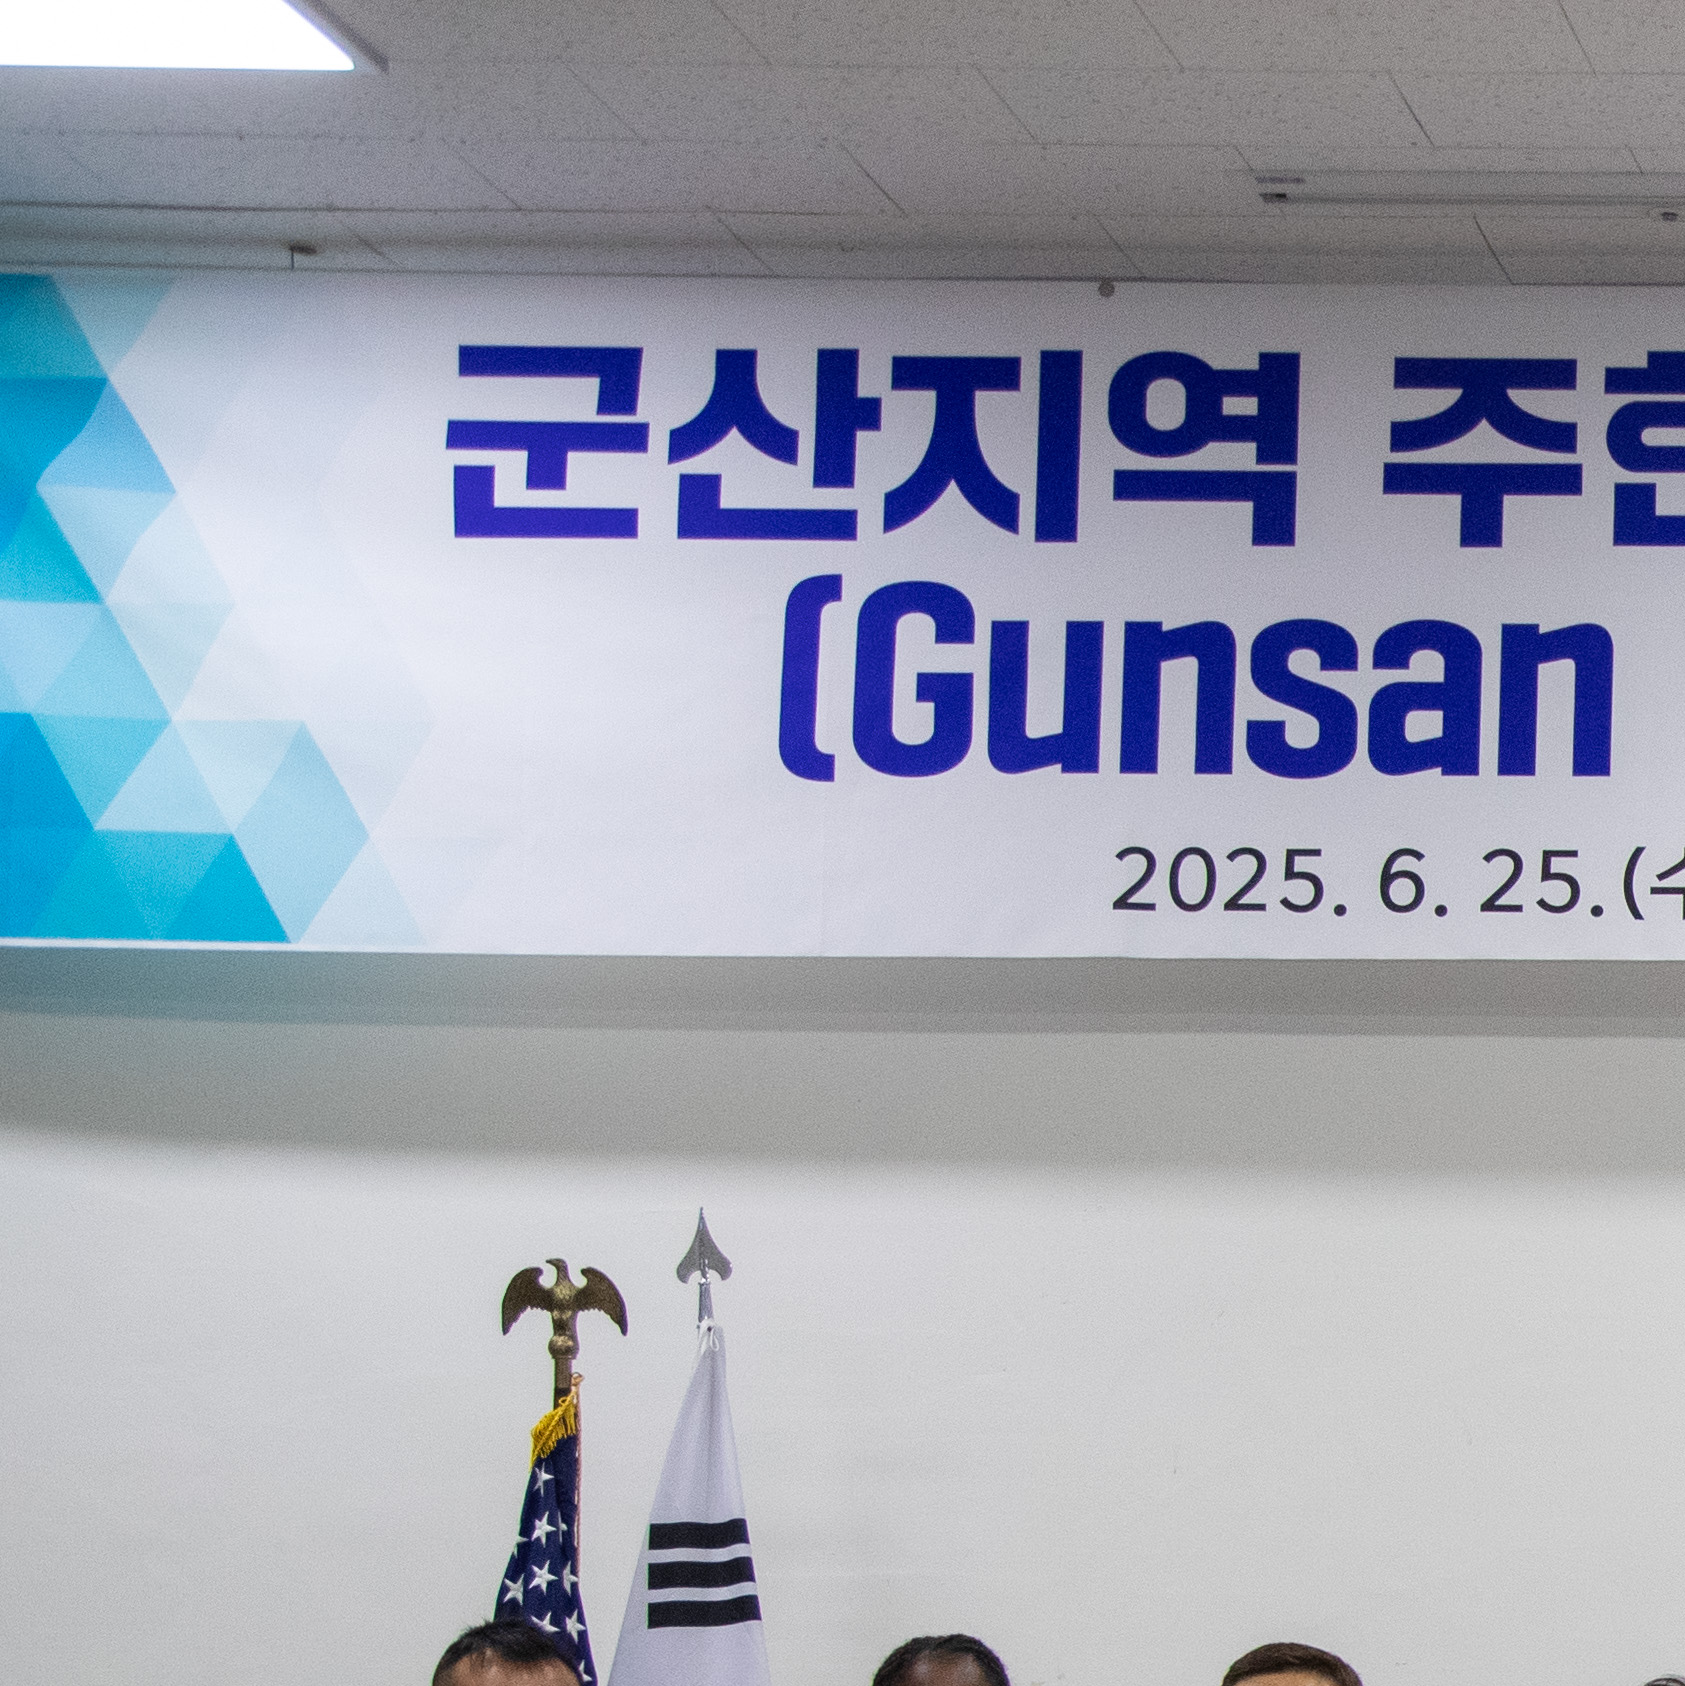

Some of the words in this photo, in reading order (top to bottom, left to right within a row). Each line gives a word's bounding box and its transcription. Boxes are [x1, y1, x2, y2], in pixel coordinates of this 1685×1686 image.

[446, 345, 1302, 547] 군산지역
[778, 574, 1614, 782] (Gunsan
[1112, 846, 1347, 917] 2025.
[1379, 847, 1448, 918] 6.
